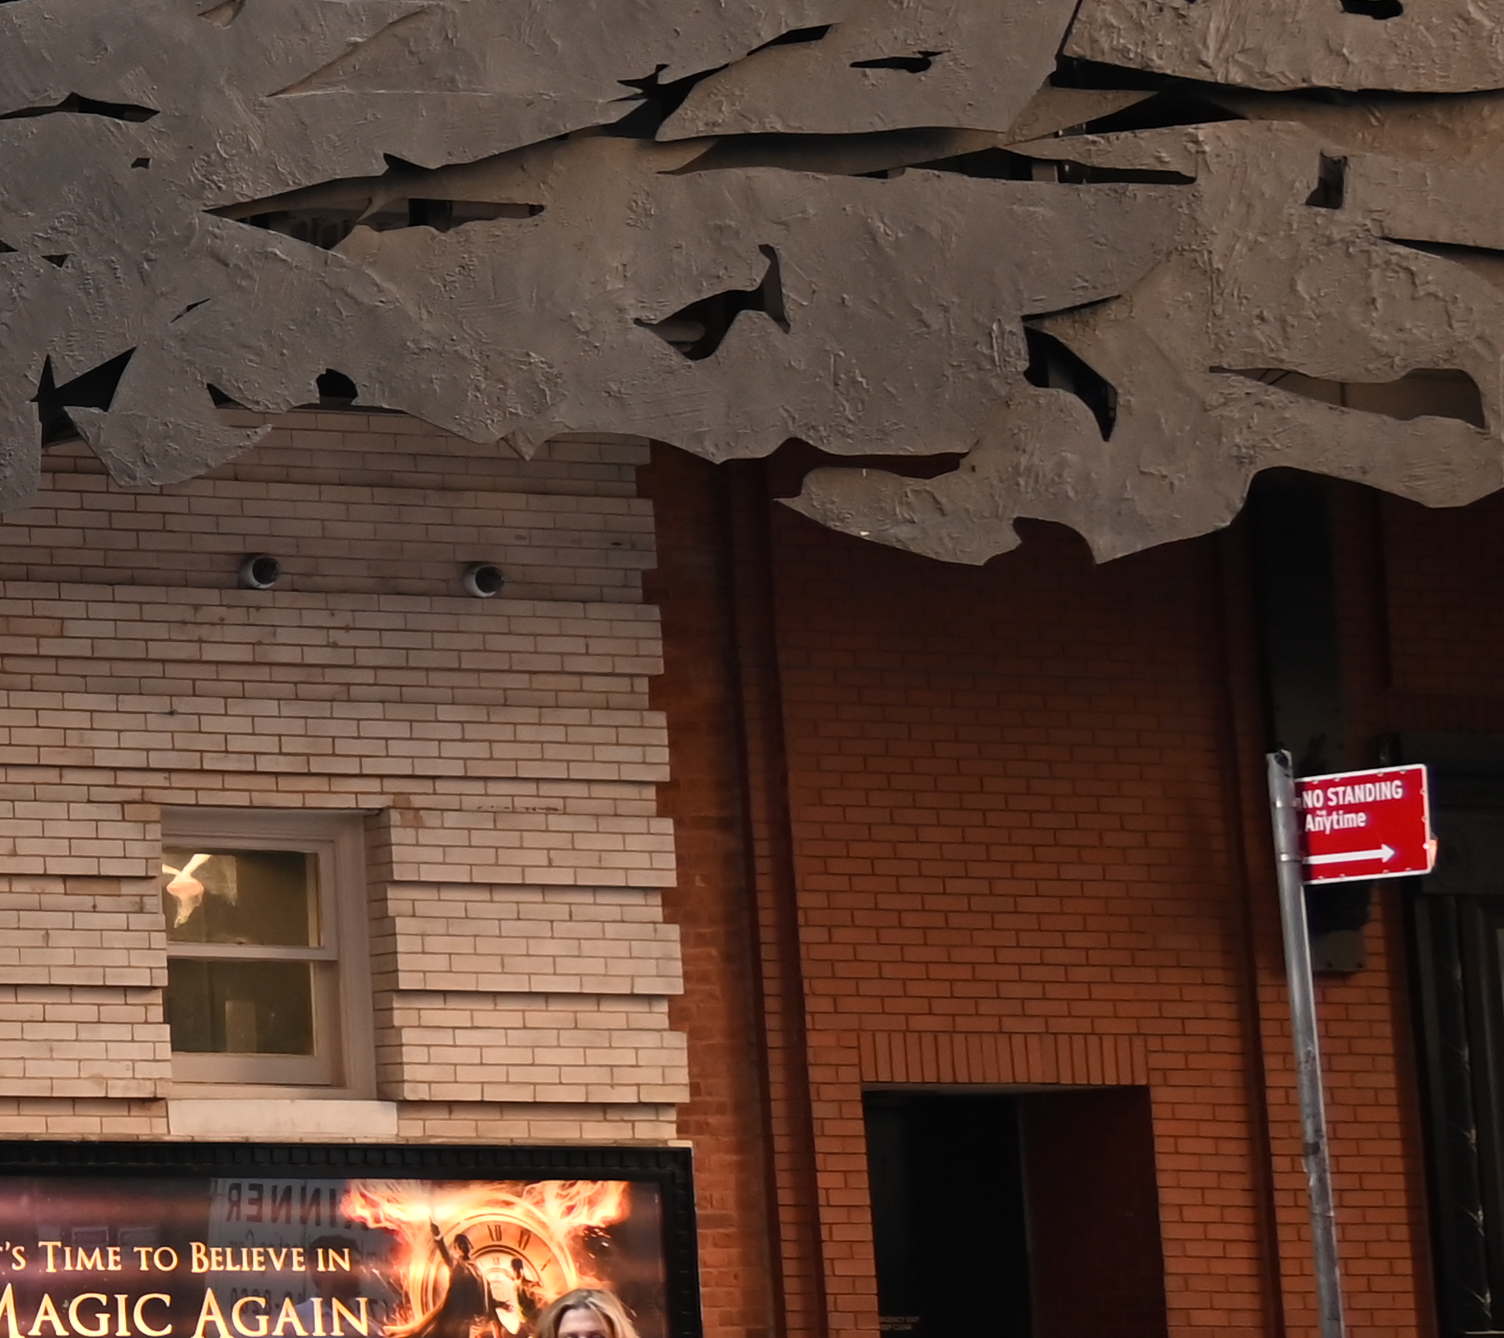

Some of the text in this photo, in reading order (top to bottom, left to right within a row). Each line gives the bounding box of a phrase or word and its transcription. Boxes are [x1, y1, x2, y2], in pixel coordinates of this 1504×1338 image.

[1302, 780, 1404, 809] NO STANDING
[1304, 810, 1368, 835] Anytime
[38, 1240, 122, 1272] TIME
[133, 1246, 179, 1271] TO
[189, 1241, 306, 1273] BELIEVE
[316, 1247, 351, 1272] IN
